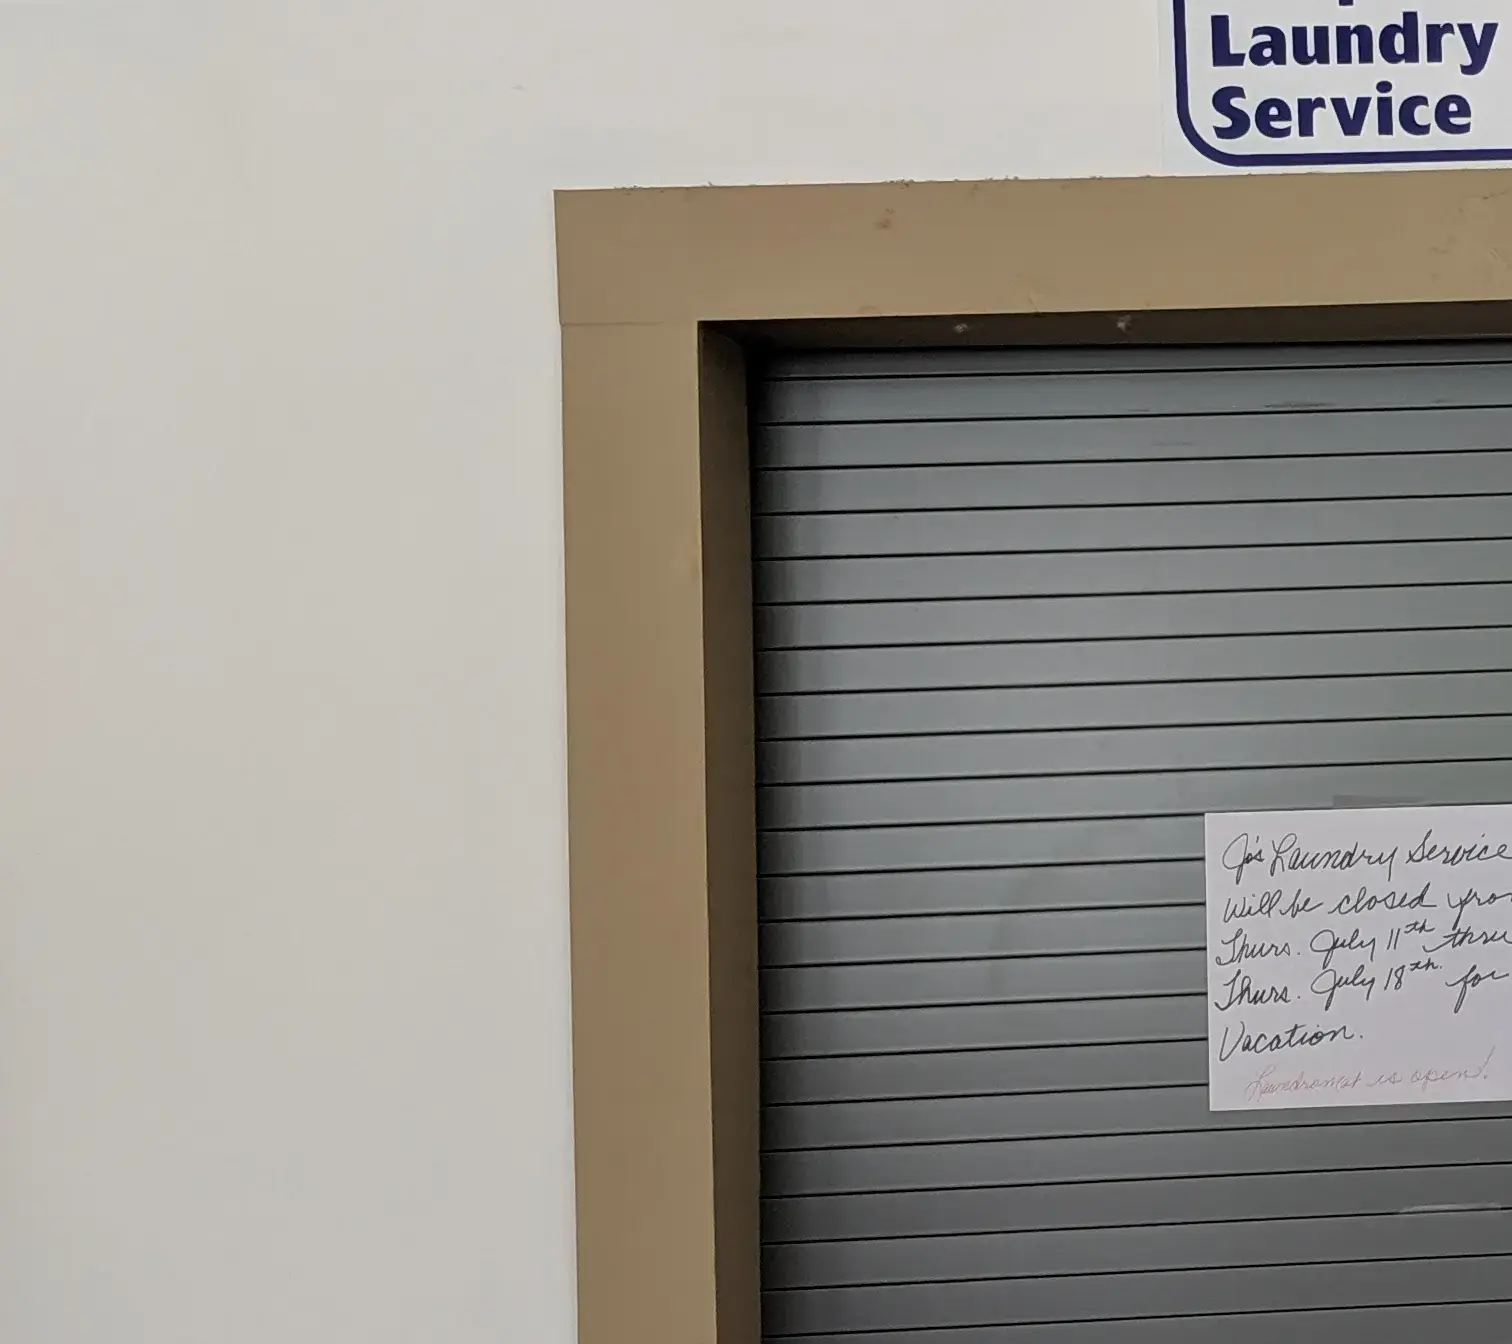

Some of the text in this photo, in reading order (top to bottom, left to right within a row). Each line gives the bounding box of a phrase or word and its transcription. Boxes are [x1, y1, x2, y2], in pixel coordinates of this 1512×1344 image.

[1210, 10, 1500, 76] Laundry
[1211, 80, 1473, 140] Service
[1270, 833, 1399, 882] Laundry
[1280, 889, 1324, 920] be
[1328, 882, 1437, 916] closed
[1215, 927, 1301, 967] Thurs.
[1309, 929, 1376, 970] July
[1214, 969, 1301, 1012] Thurs.
[1310, 968, 1376, 1012] July
[1445, 965, 1510, 1014] for
[1219, 1021, 1364, 1062] Vacation.
[1366, 1073, 1403, 1088] is
